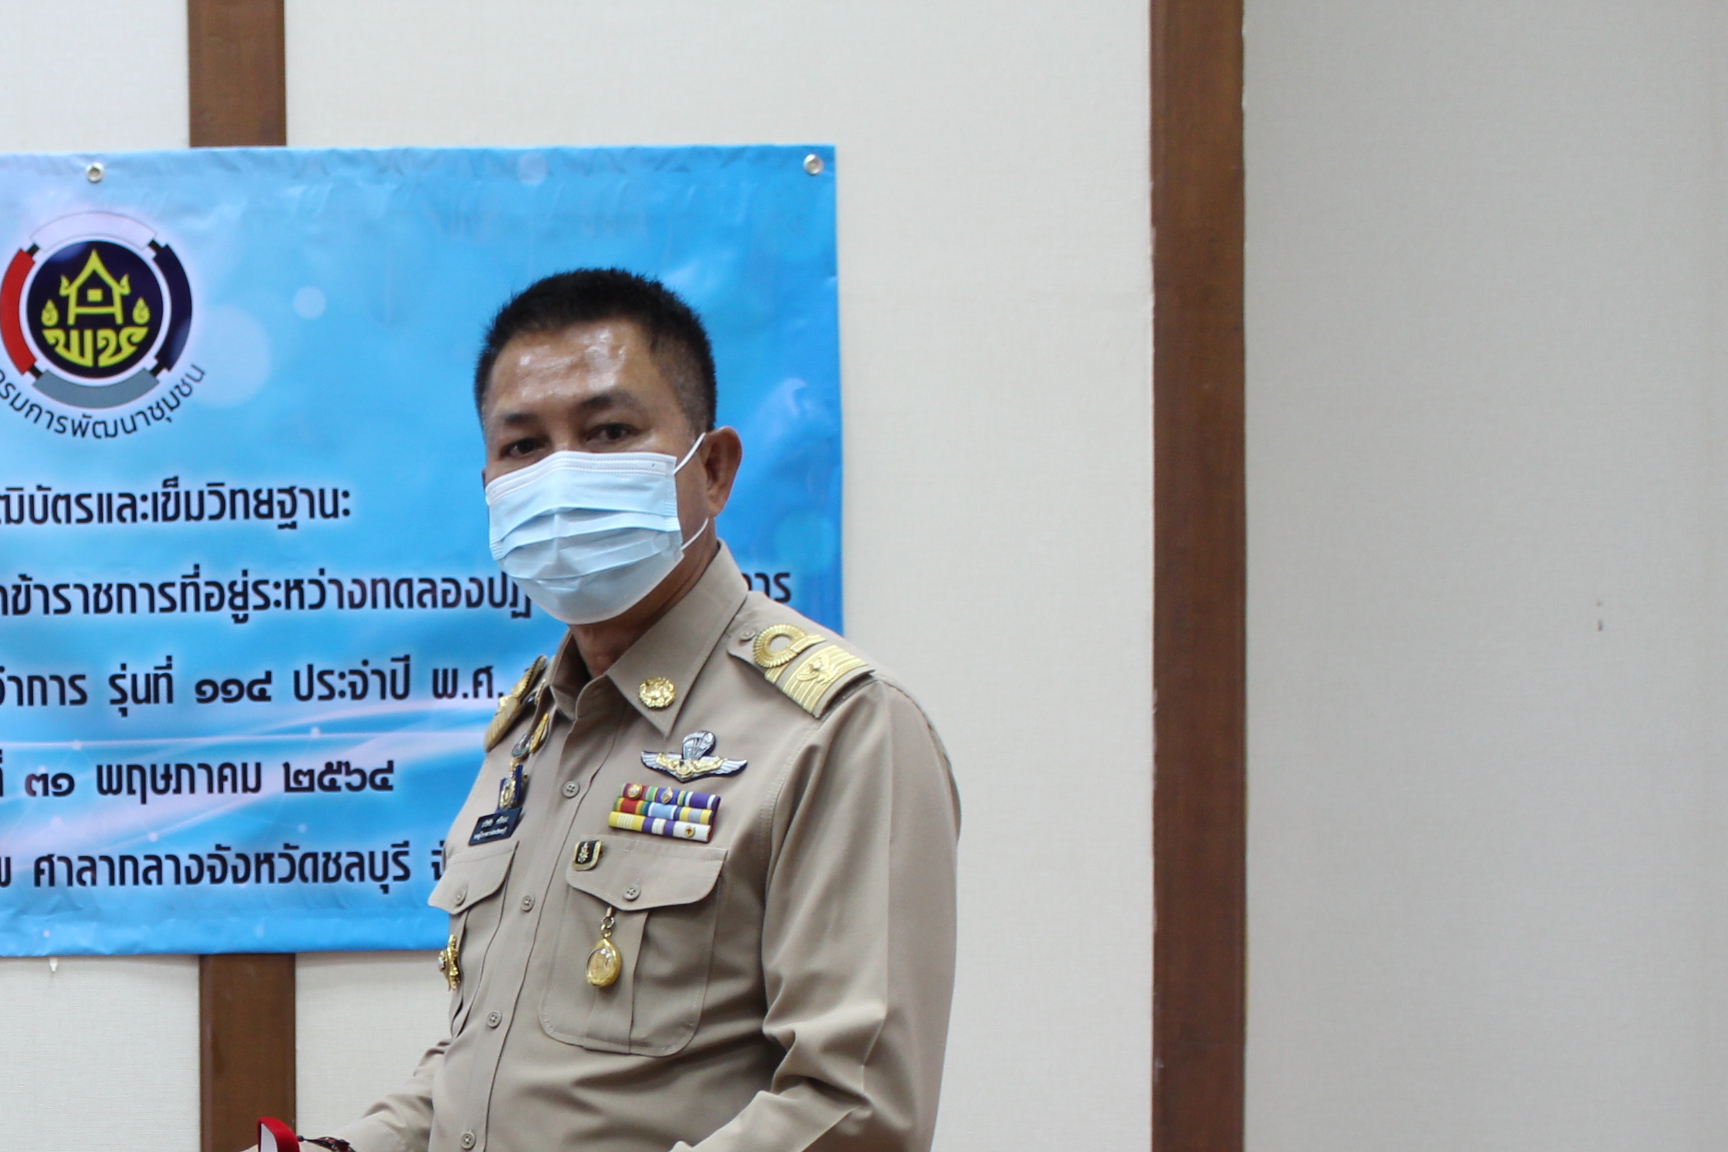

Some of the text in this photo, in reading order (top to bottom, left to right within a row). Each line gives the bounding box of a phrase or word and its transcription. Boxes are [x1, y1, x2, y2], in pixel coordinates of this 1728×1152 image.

[108, 655, 174, 718] รุ่นที่
[194, 670, 273, 704] ๑๑๔
[293, 654, 412, 702] ประจำปี
[25, 772, 75, 797] ๓๑
[96, 762, 262, 805] พฤษภาคม
[282, 760, 394, 793] ๒๕๖๔
[33, 840, 411, 895] ศาลากลางจังหวัดชลบุรี
